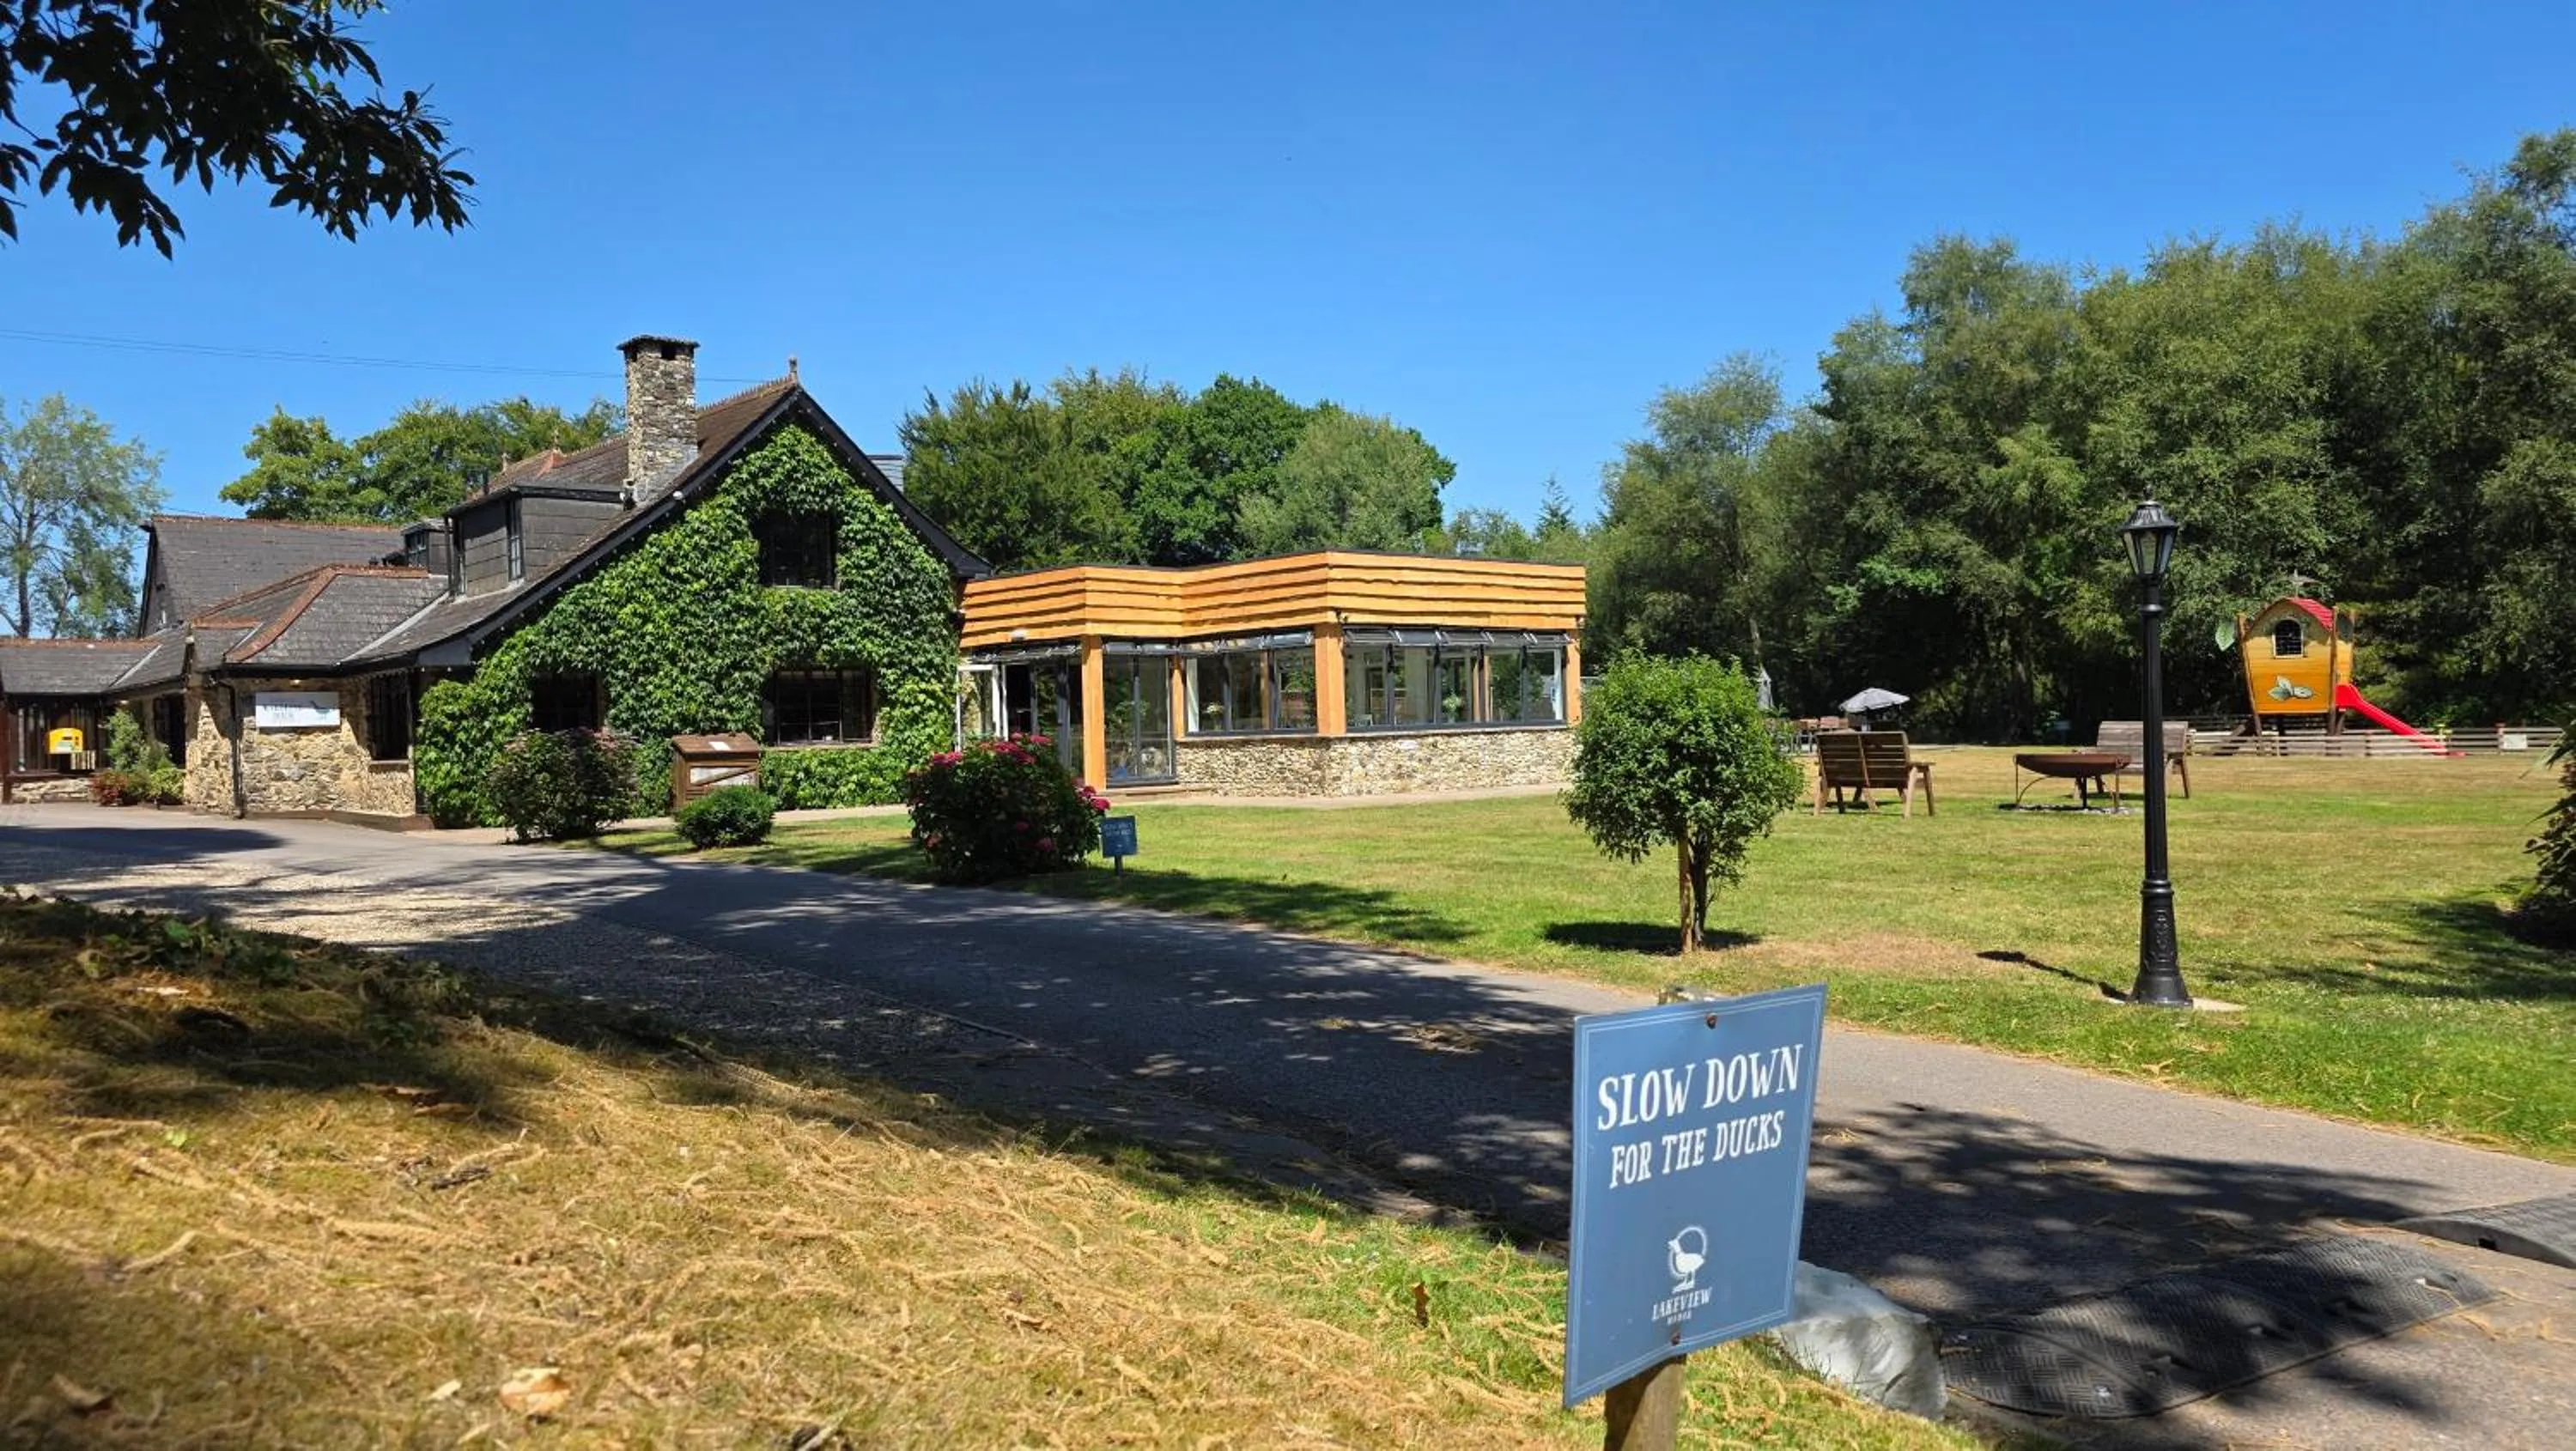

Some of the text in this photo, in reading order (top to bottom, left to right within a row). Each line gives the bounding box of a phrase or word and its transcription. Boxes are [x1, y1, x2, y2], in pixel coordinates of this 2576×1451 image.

[1598, 1044, 1803, 1131] SLOW DOWN
[1609, 1110, 1784, 1189] FOR THE DUCKS
[1651, 1287, 1713, 1322] LAKEVIEW
